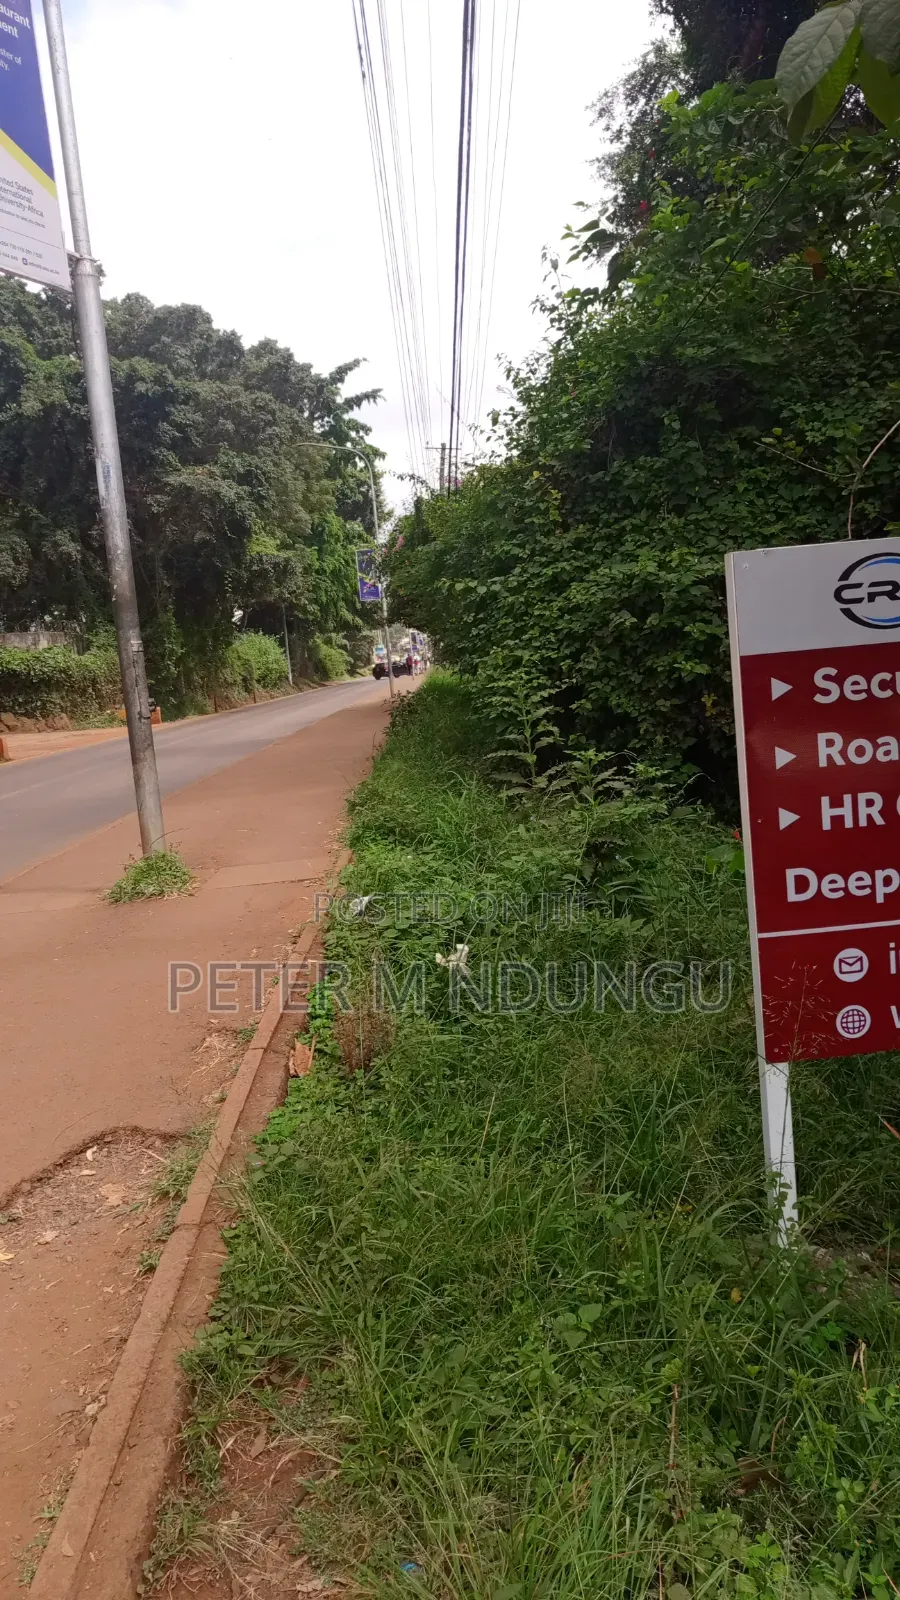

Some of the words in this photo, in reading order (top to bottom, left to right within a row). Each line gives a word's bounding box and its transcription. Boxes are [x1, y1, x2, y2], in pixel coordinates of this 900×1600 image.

[15, 181, 34, 196] States
[817, 732, 900, 767] Roa
[820, 791, 886, 831] HR
[785, 867, 900, 905] Deep
